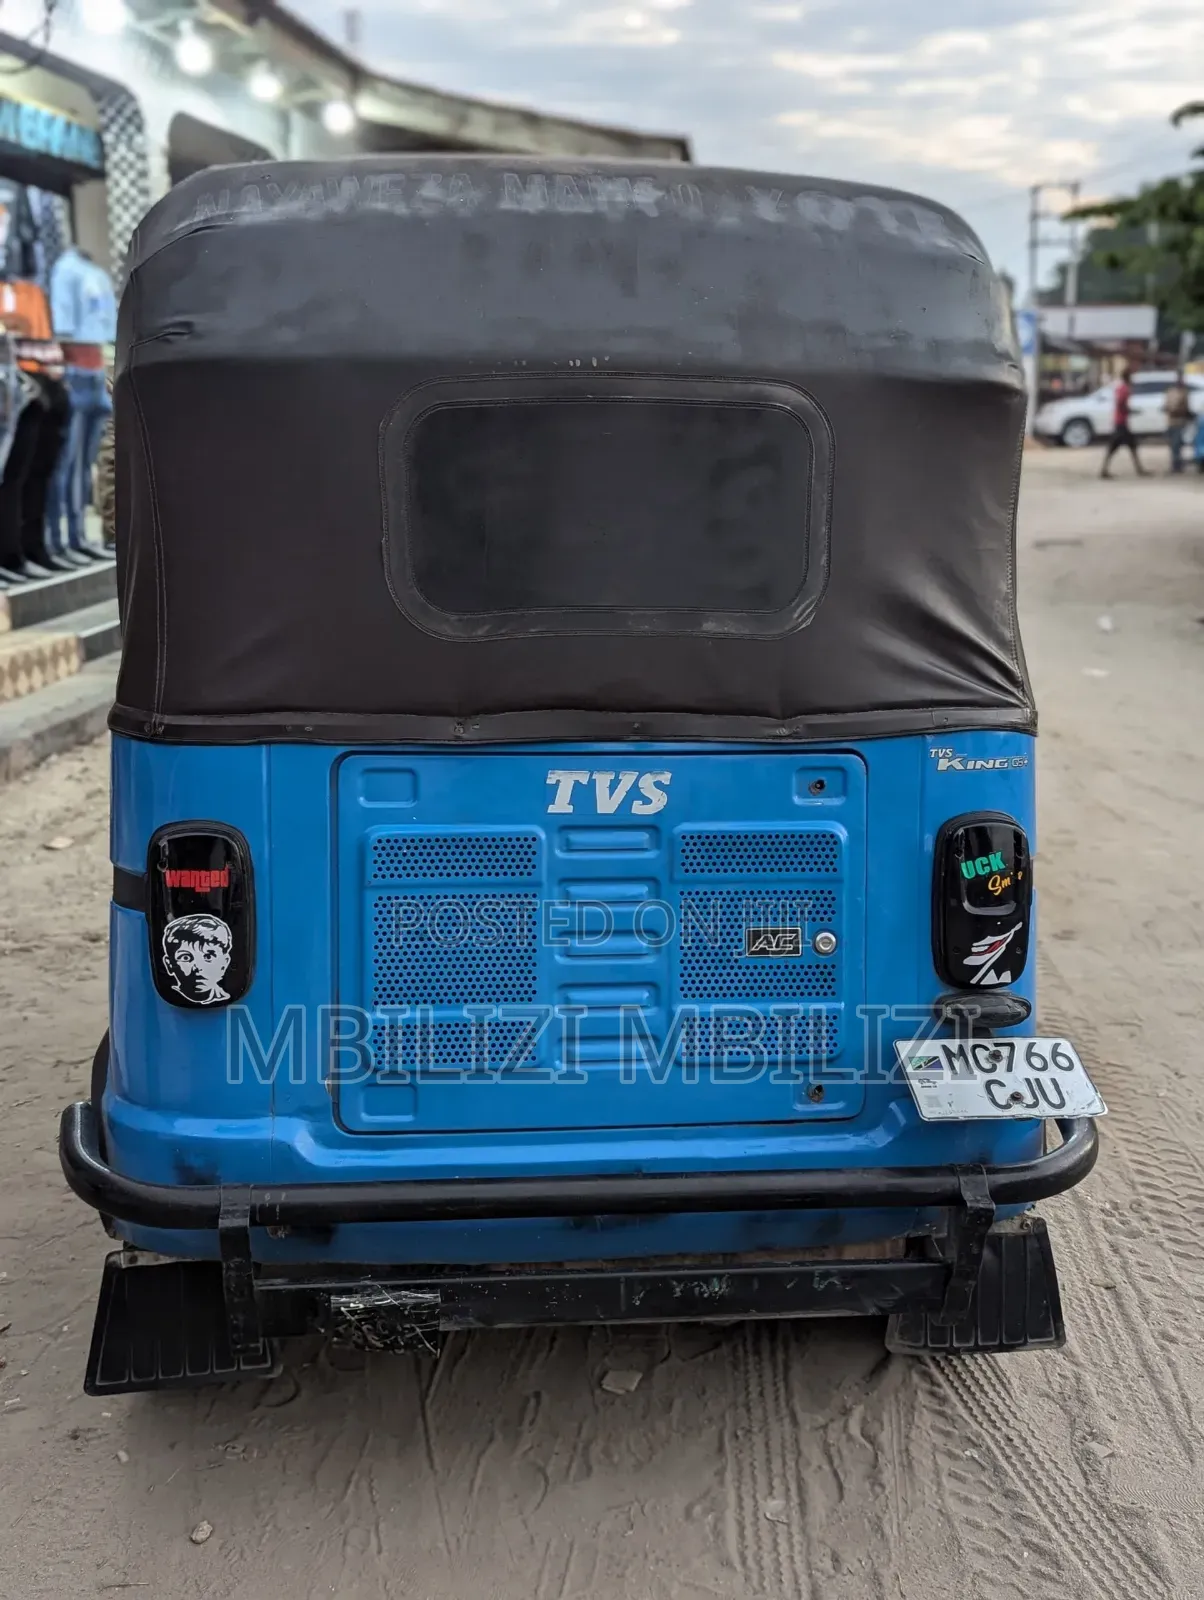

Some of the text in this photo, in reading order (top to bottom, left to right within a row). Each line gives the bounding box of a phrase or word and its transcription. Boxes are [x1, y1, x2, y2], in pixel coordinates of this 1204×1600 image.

[929, 748, 953, 758] TVS
[546, 769, 673, 815] TVS
[984, 1077, 1067, 1110] CJU
